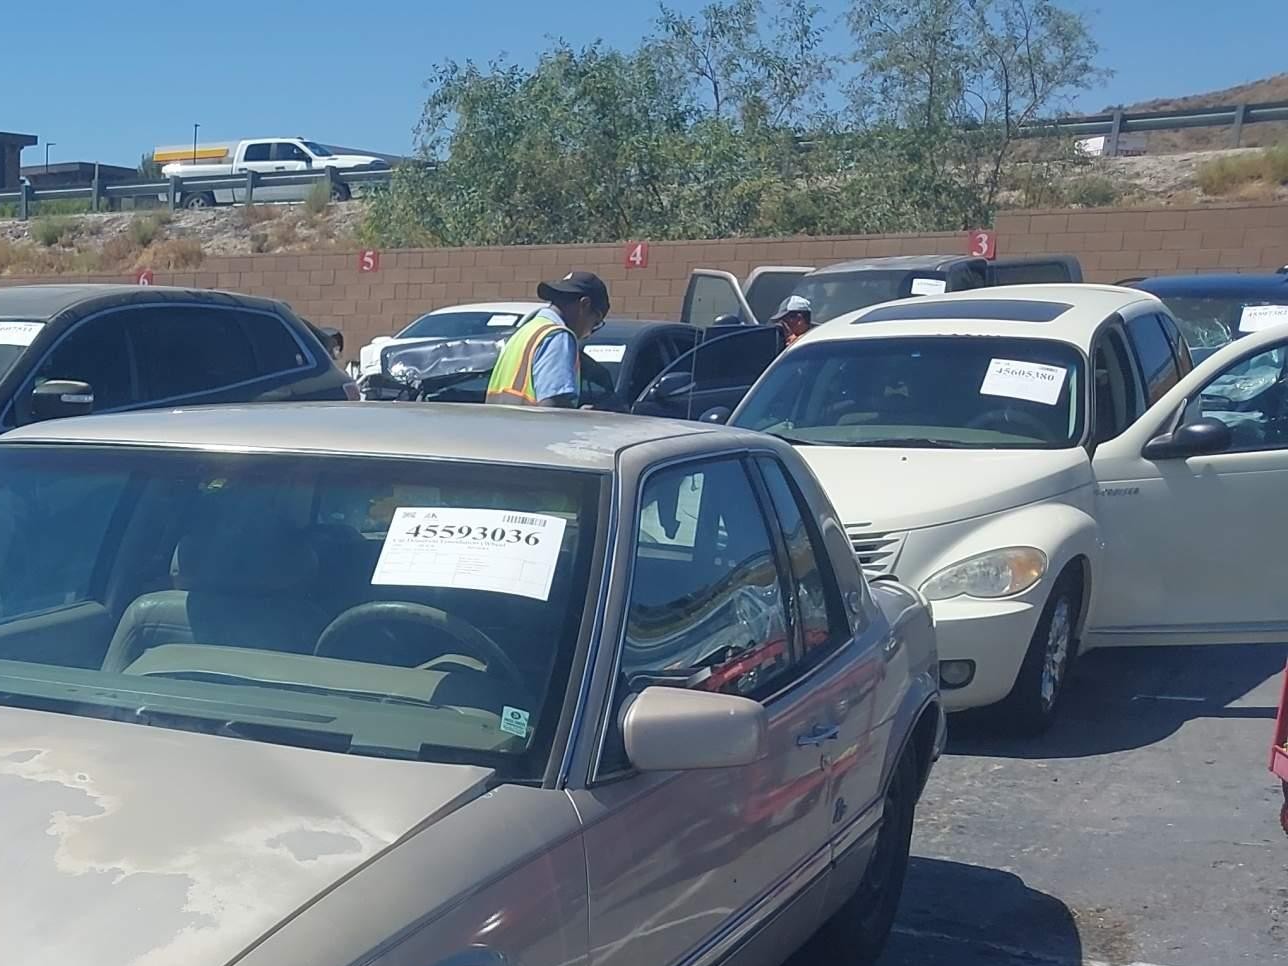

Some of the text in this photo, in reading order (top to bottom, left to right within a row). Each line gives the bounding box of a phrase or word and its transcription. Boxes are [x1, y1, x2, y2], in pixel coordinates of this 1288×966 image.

[630, 244, 642, 264] 4
[972, 233, 988, 257] 3
[362, 250, 374, 270] 5
[139, 273, 148, 286] 6
[405, 524, 542, 546] 45593036
